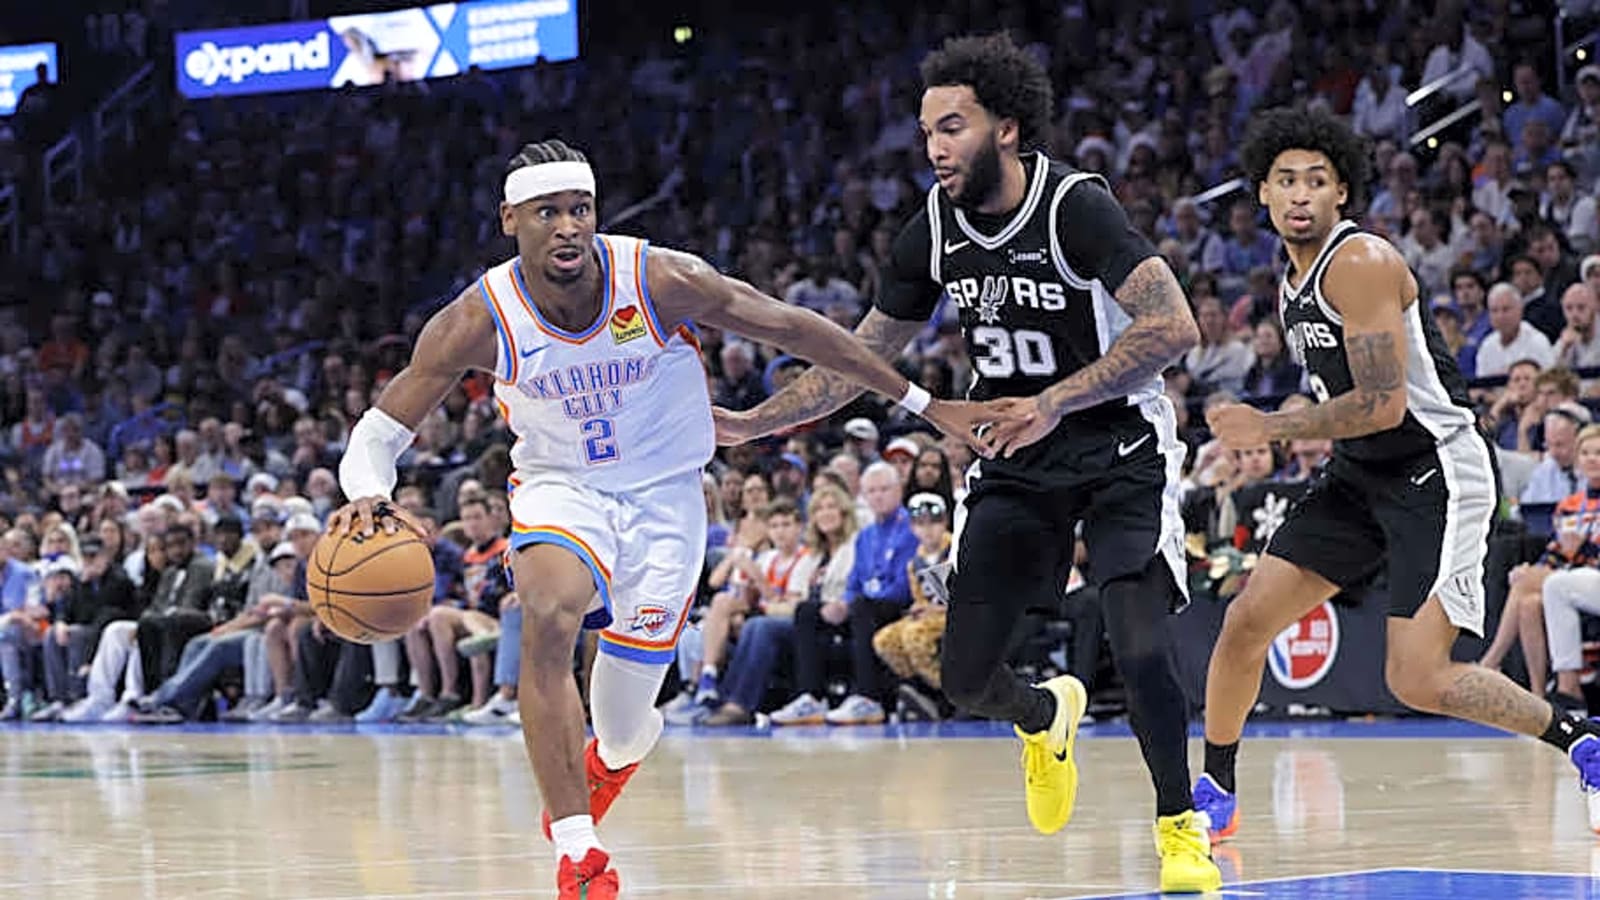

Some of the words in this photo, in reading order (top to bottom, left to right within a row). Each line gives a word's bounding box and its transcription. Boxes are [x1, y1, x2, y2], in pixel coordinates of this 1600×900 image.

[186, 33, 329, 84] expand
[972, 326, 1058, 378] 30
[562, 387, 622, 420] CITY
[580, 416, 620, 465] 2
